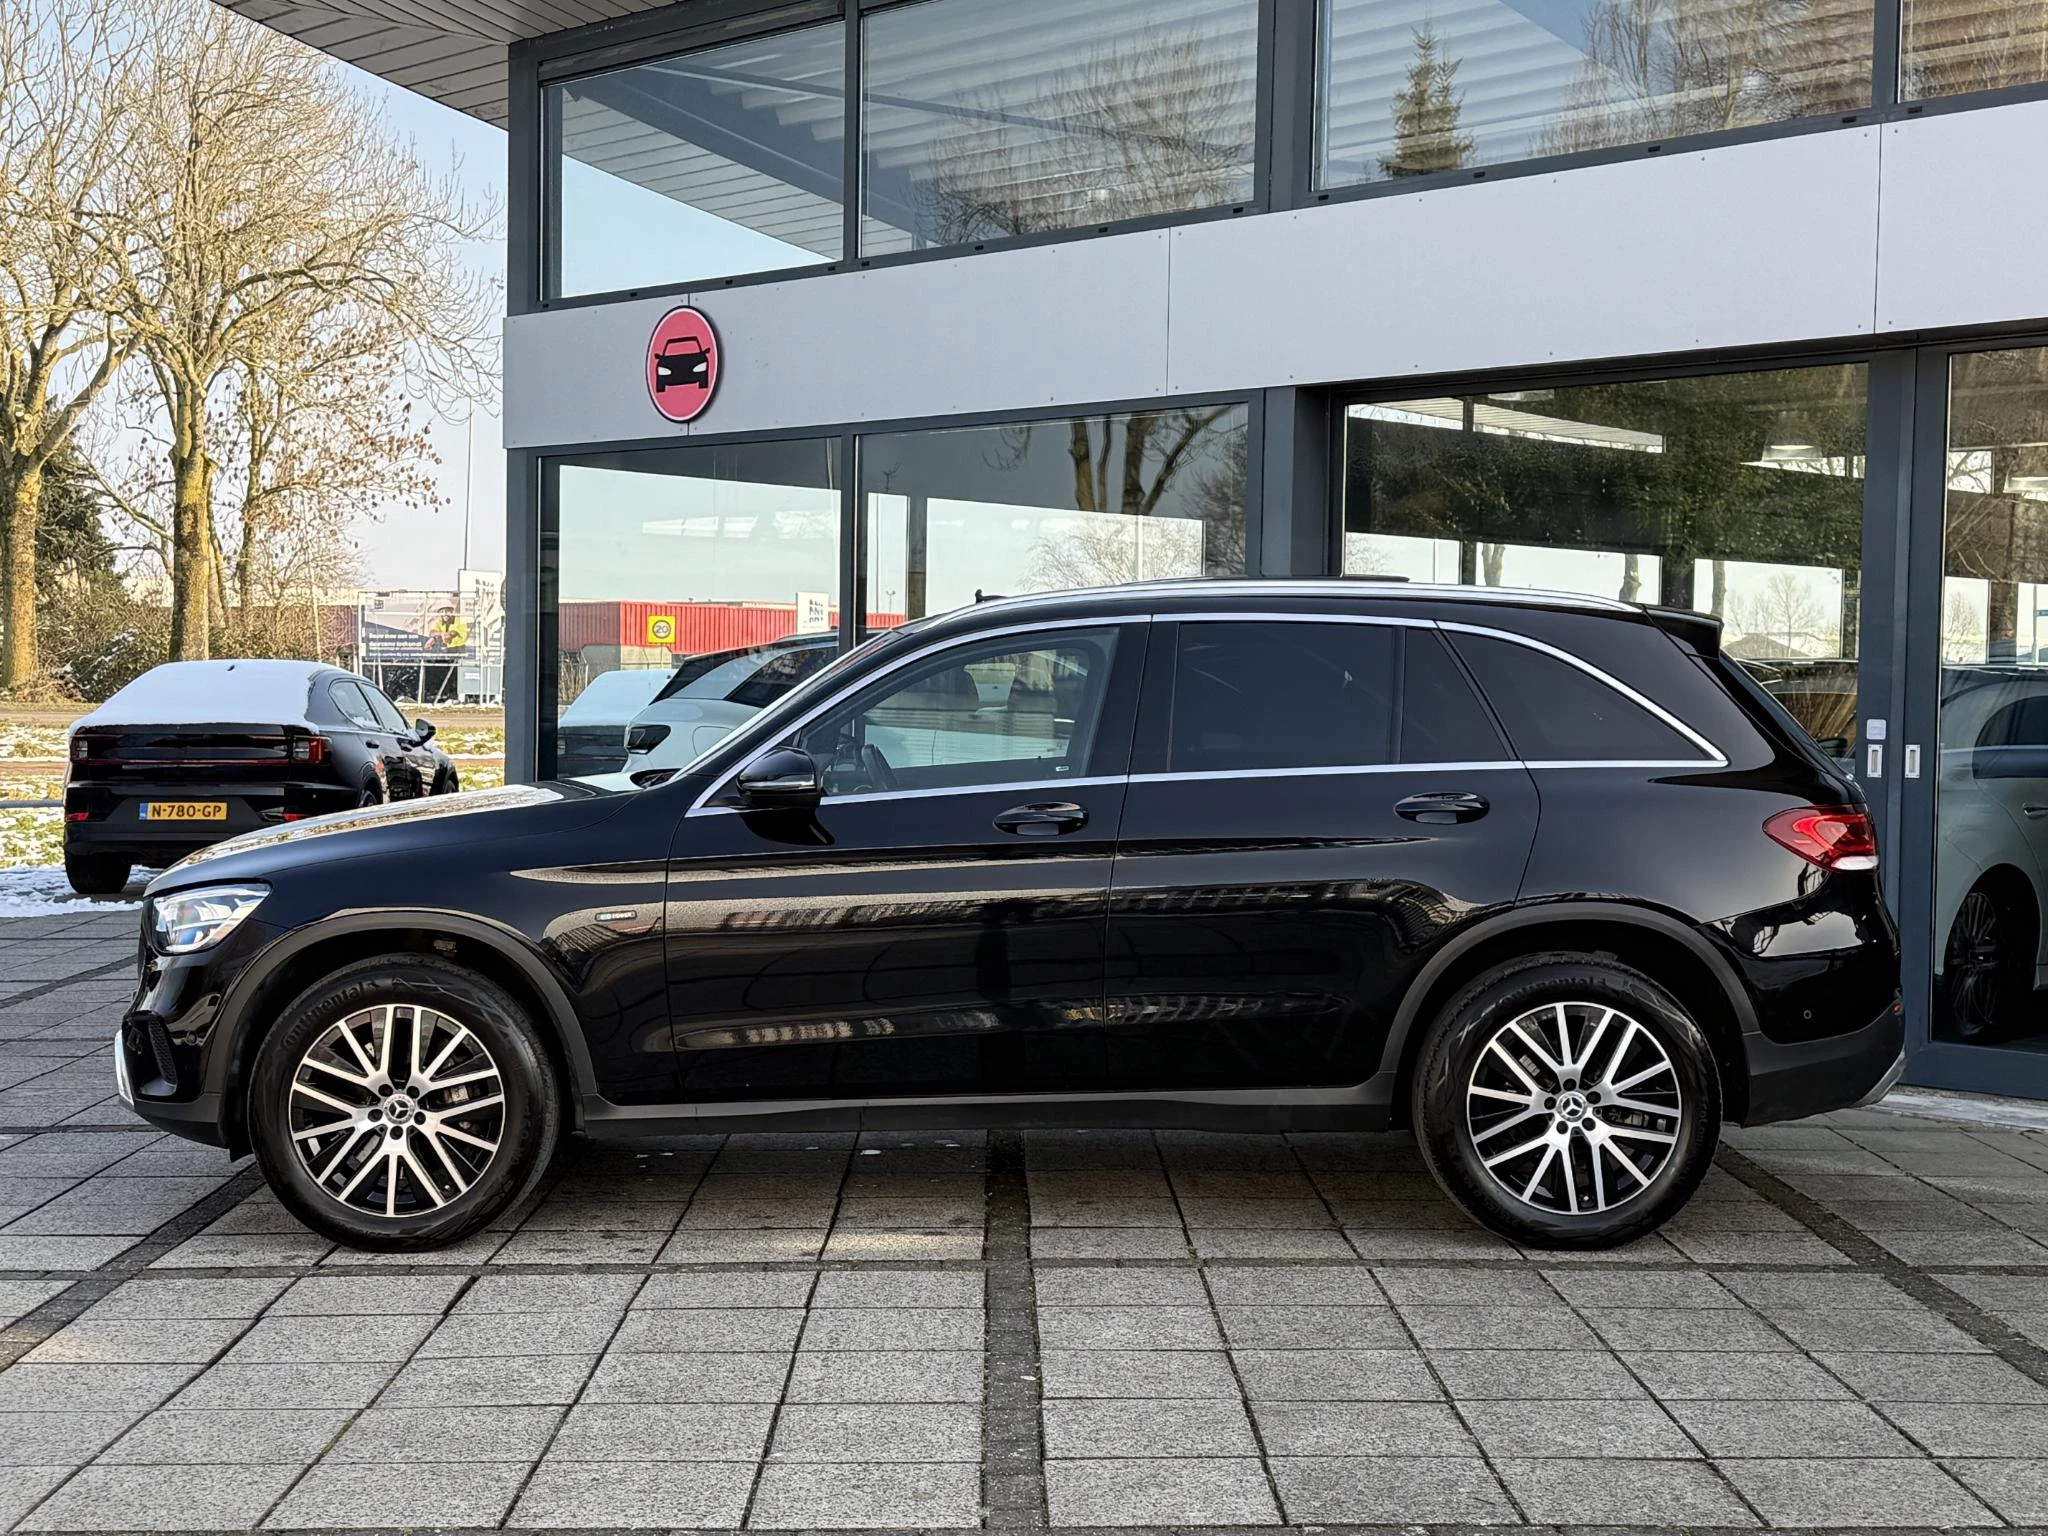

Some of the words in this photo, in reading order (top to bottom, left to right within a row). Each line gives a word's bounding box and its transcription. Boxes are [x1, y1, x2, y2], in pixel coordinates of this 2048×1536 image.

[655, 625, 670, 634] 20
[152, 804, 222, 818] N-780-GP
[281, 982, 364, 1049] Continental
